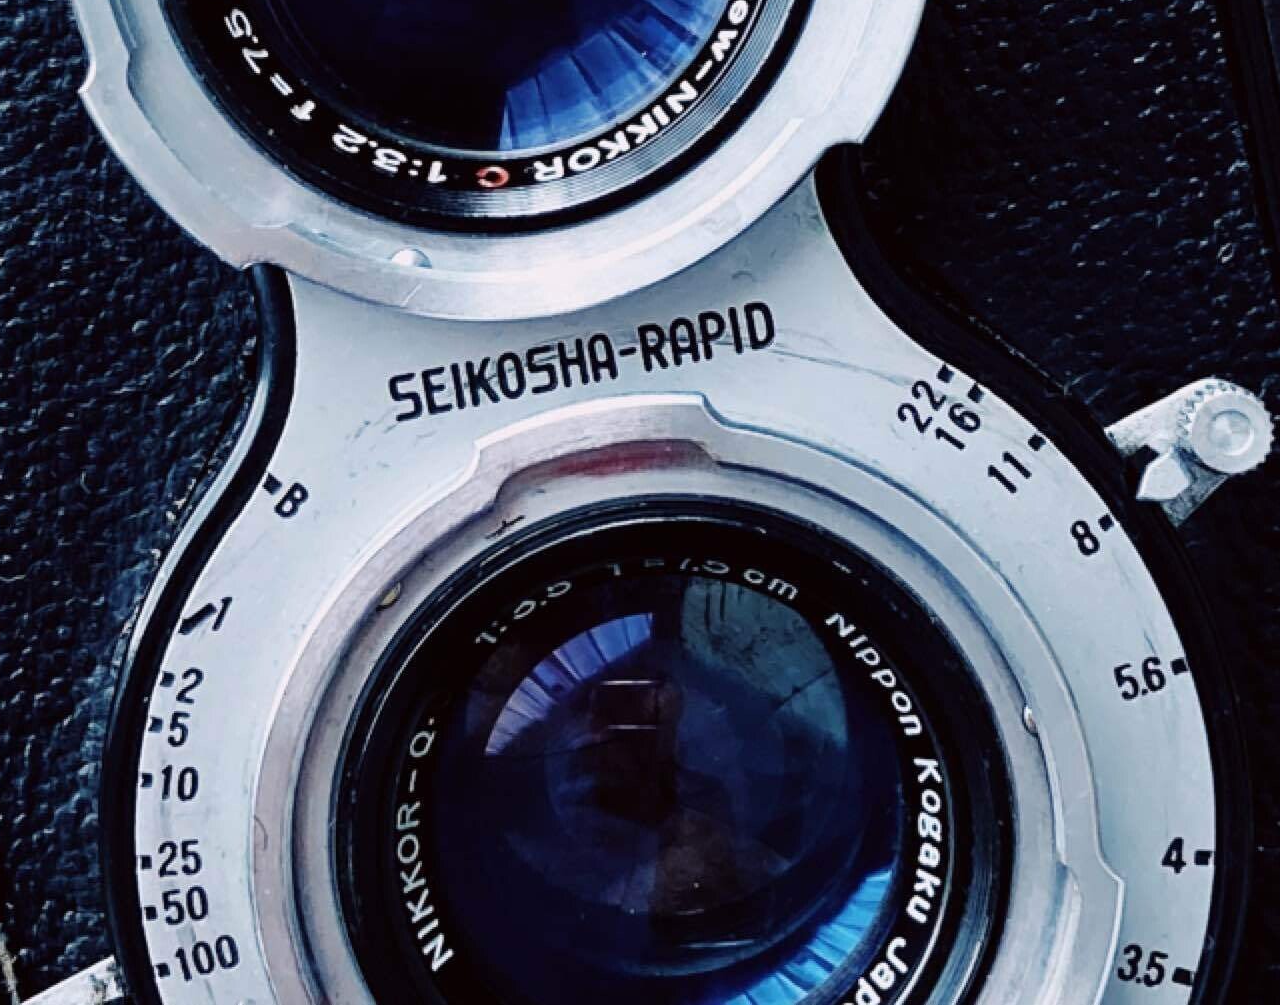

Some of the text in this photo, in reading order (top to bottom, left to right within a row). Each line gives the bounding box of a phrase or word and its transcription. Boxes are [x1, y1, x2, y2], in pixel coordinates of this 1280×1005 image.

[388, 300, 775, 422] SEIKOSHA-RAPID
[897, 380, 946, 434] 22
[935, 402, 981, 451] 16
[987, 451, 1032, 494] 11
[274, 482, 309, 519] B
[1070, 519, 1100, 557] 8
[742, 567, 798, 601] cm
[212, 596, 234, 633] 1
[176, 667, 205, 705] 2
[824, 611, 924, 738] Nippon
[1113, 655, 1167, 701] 5.6
[167, 711, 190, 747] 5
[160, 766, 199, 802] 10
[157, 839, 203, 878] 25
[906, 757, 943, 925] Kogaku
[1161, 838, 1187, 875] 4
[160, 886, 209, 926] 50
[173, 934, 240, 982] 100
[841, 936, 909, 1005] Jap
[1116, 945, 1169, 988] 3.5
